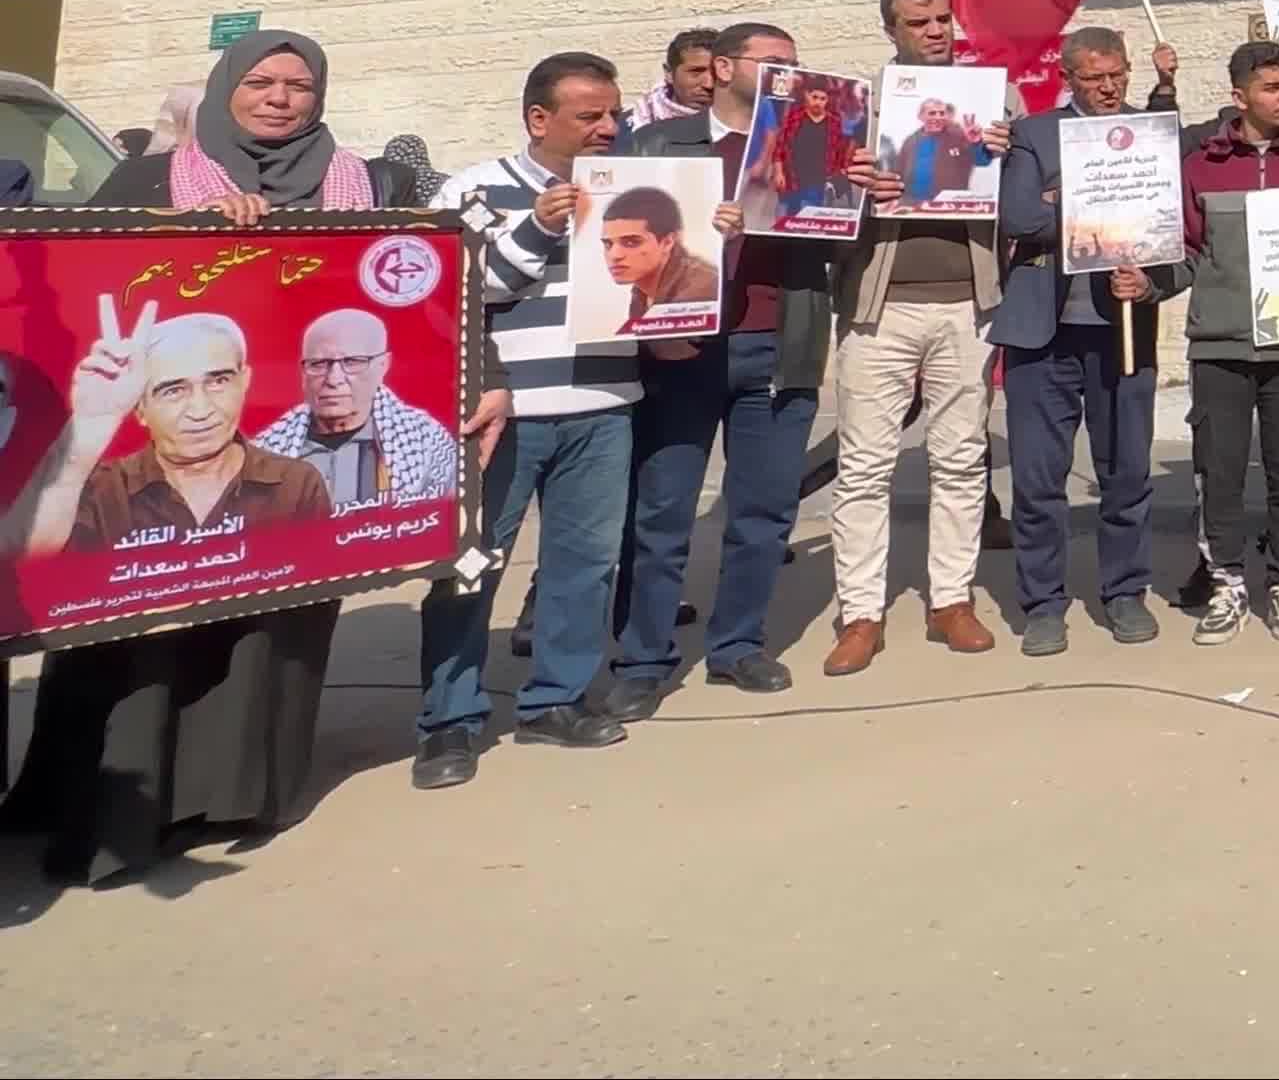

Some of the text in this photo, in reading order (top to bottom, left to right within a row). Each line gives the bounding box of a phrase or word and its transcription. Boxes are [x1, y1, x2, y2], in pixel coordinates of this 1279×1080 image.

[113, 514, 245, 551] الأسير القائد
[334, 511, 440, 546] كريم يونس
[107, 541, 247, 584] أحمد سعدات
